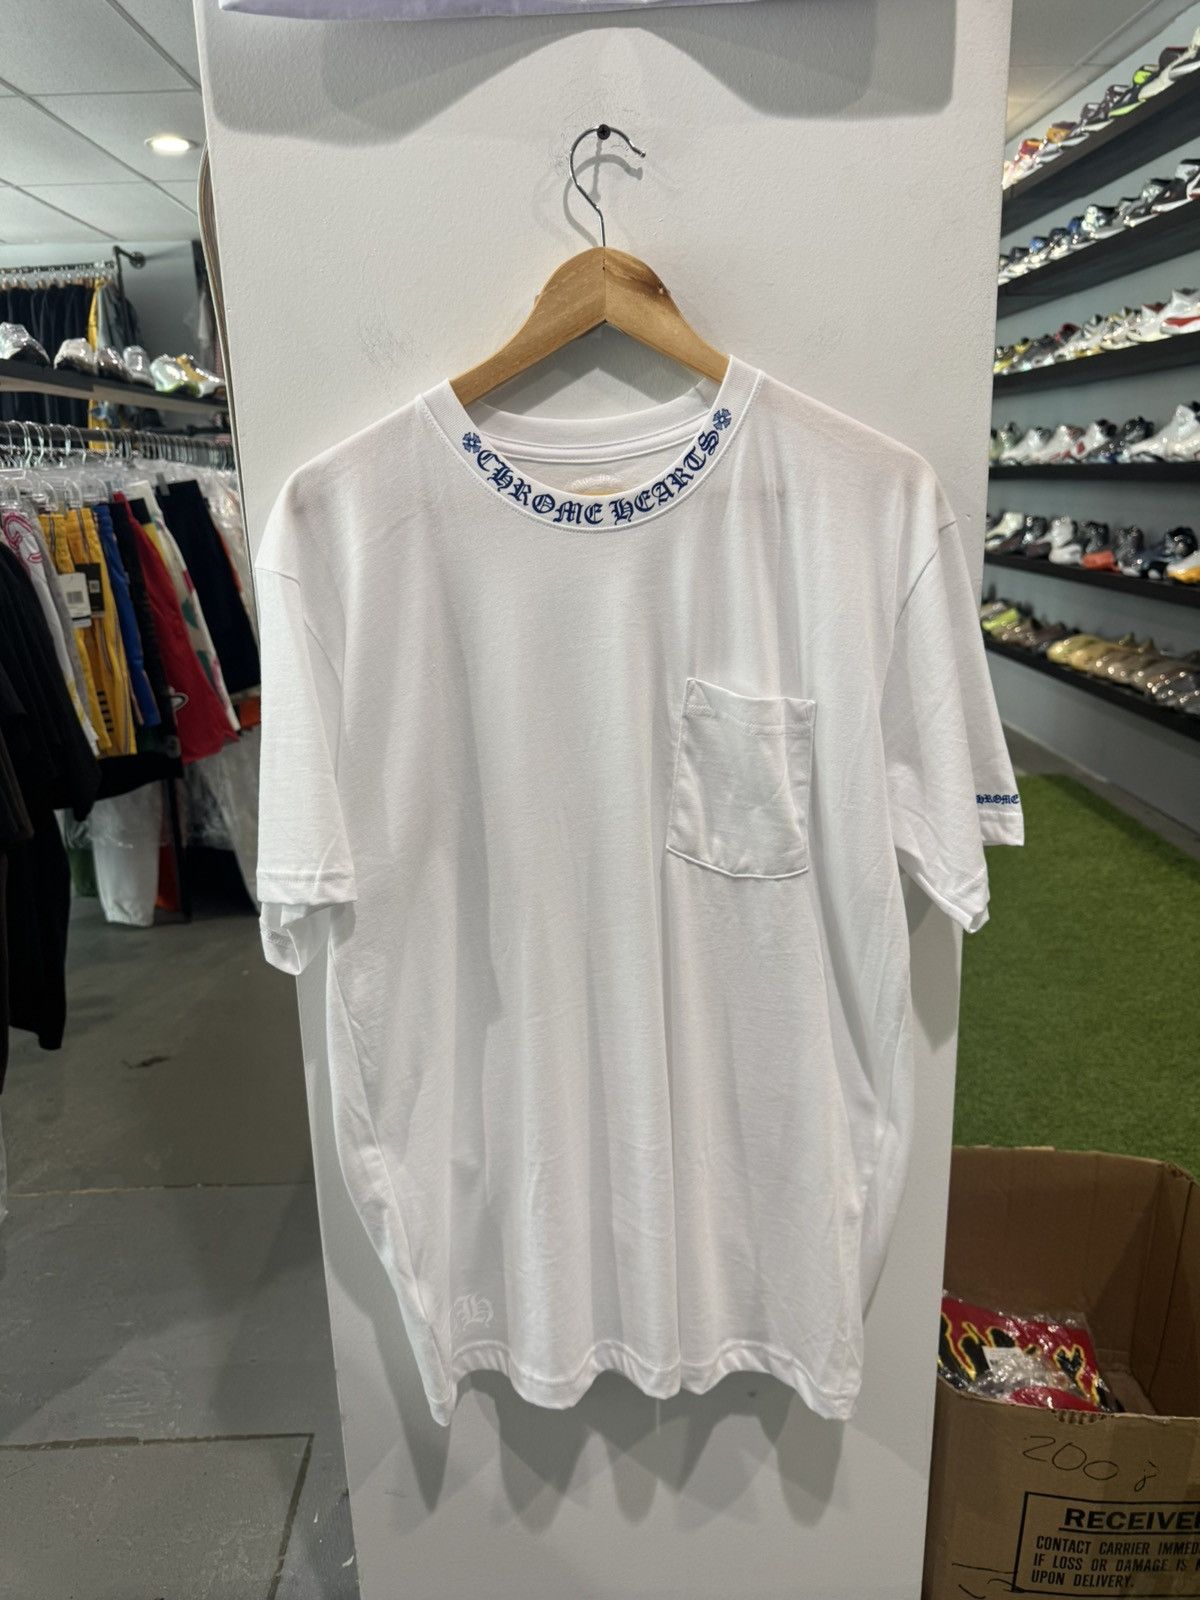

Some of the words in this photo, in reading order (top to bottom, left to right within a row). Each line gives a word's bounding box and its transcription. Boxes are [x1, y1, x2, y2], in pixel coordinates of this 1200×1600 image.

[477, 449, 603, 525] CHROME
[608, 430, 719, 525] HEARTS
[1022, 1435, 1120, 1481] 200
[1036, 1536, 1092, 1555] CONTACT
[1099, 1541, 1150, 1555] CARRIER
[1158, 1541, 1200, 1555] IMMED
[1033, 1553, 1046, 1567] IF
[1052, 1555, 1083, 1571] LOSS
[1091, 1559, 1107, 1572] OR
[1115, 1558, 1168, 1572] DAMAGE
[1176, 1558, 1188, 1572] IS
[1031, 1569, 1066, 1586] UPON
[1073, 1573, 1134, 1588] DELIVERY.
